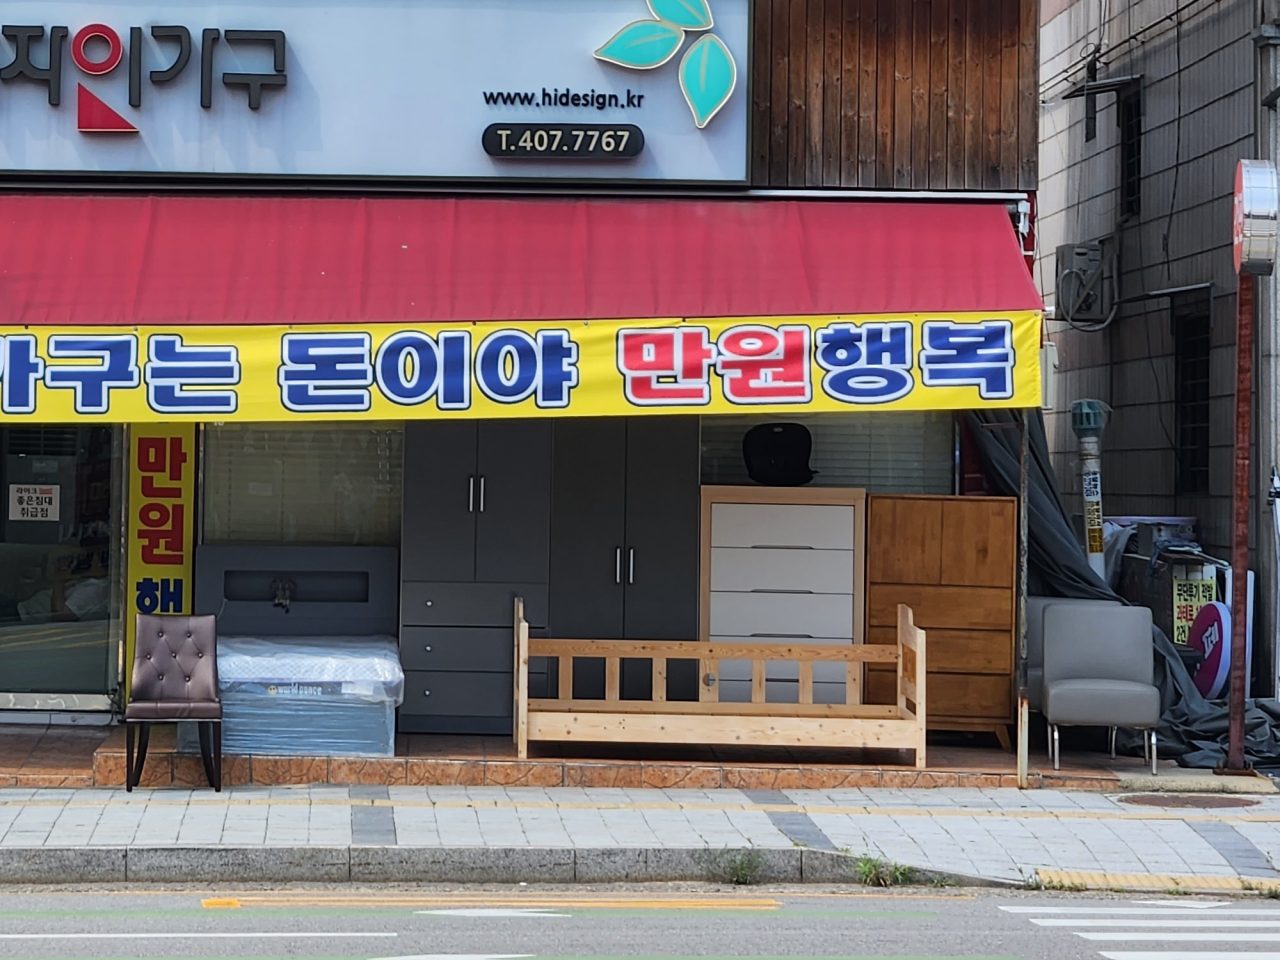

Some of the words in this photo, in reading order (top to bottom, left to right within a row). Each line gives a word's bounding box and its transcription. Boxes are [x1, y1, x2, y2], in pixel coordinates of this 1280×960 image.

[483, 88, 645, 110] www.hidesign.kr
[497, 129, 630, 151] T.407.7767
[278, 329, 580, 412] 돈이야
[136, 436, 188, 566] 만원
